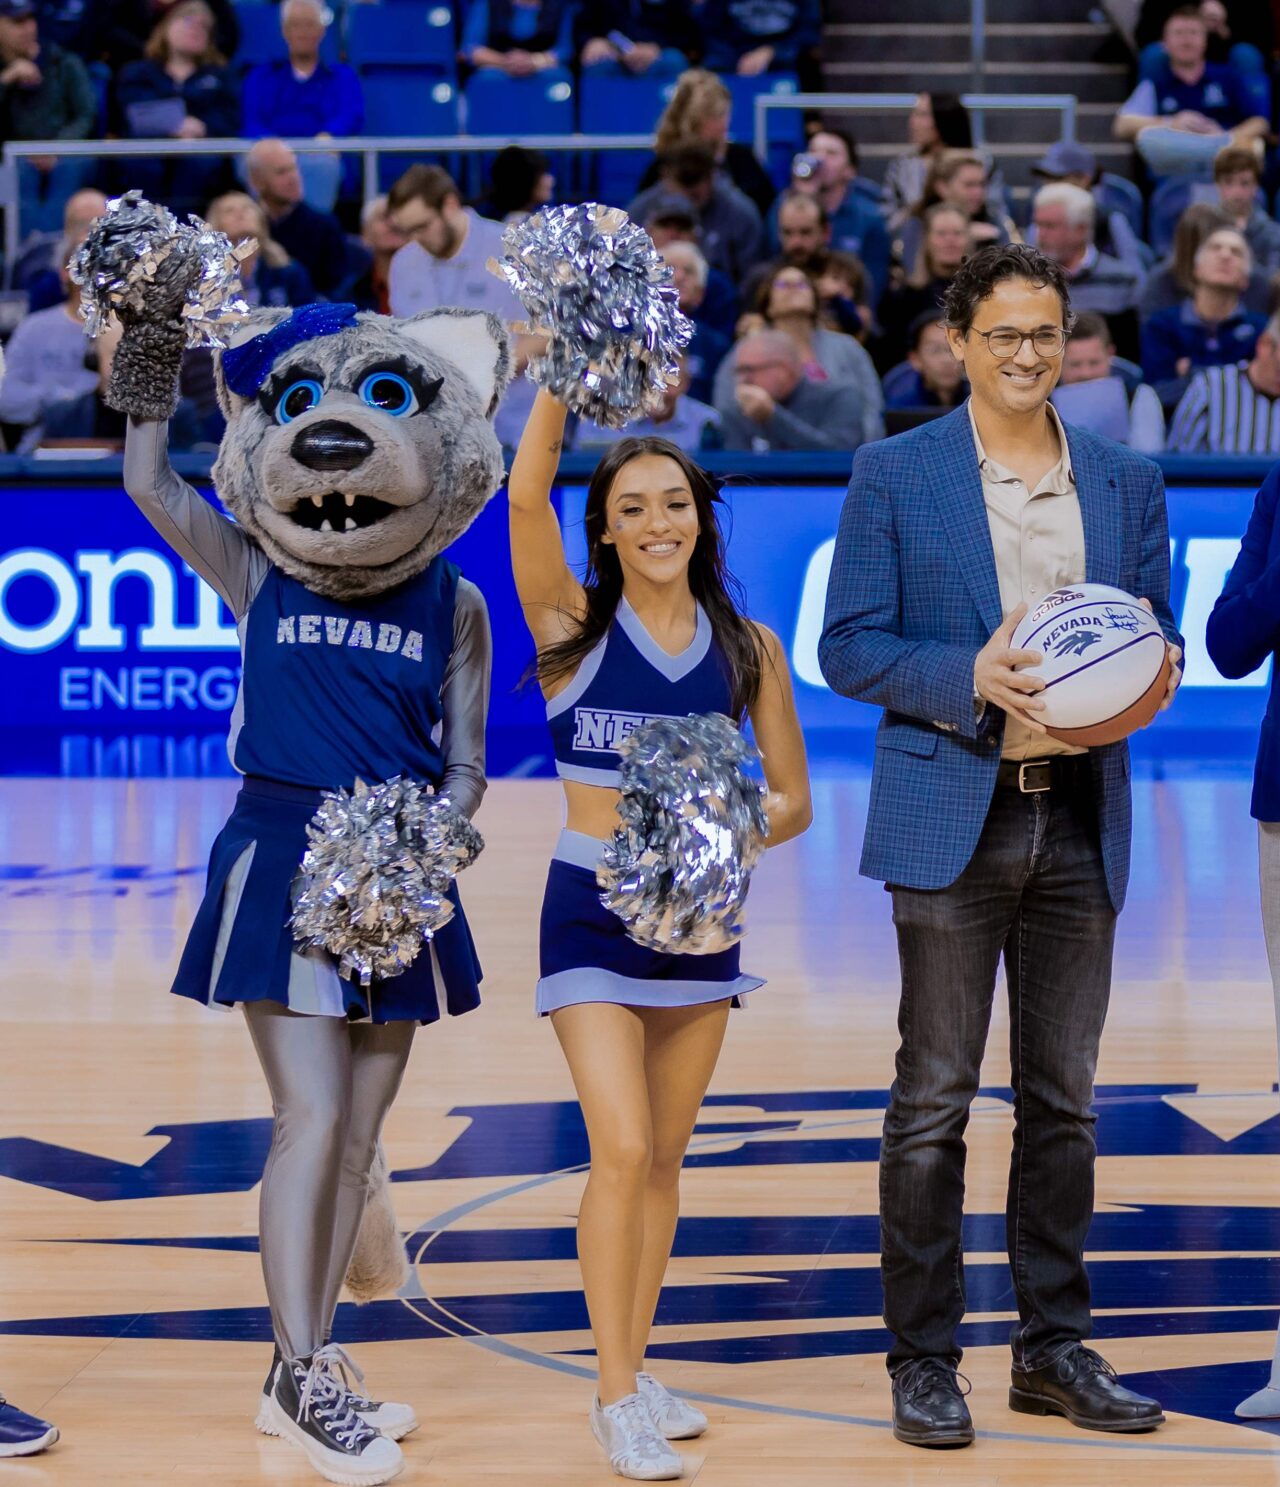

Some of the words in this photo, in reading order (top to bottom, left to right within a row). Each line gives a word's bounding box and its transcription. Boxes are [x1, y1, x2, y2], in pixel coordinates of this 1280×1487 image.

[1032, 592, 1085, 622] adidas
[276, 615, 424, 663] NEVADA
[1042, 616, 1105, 653] NEVADA
[60, 665, 243, 711] ENERG
